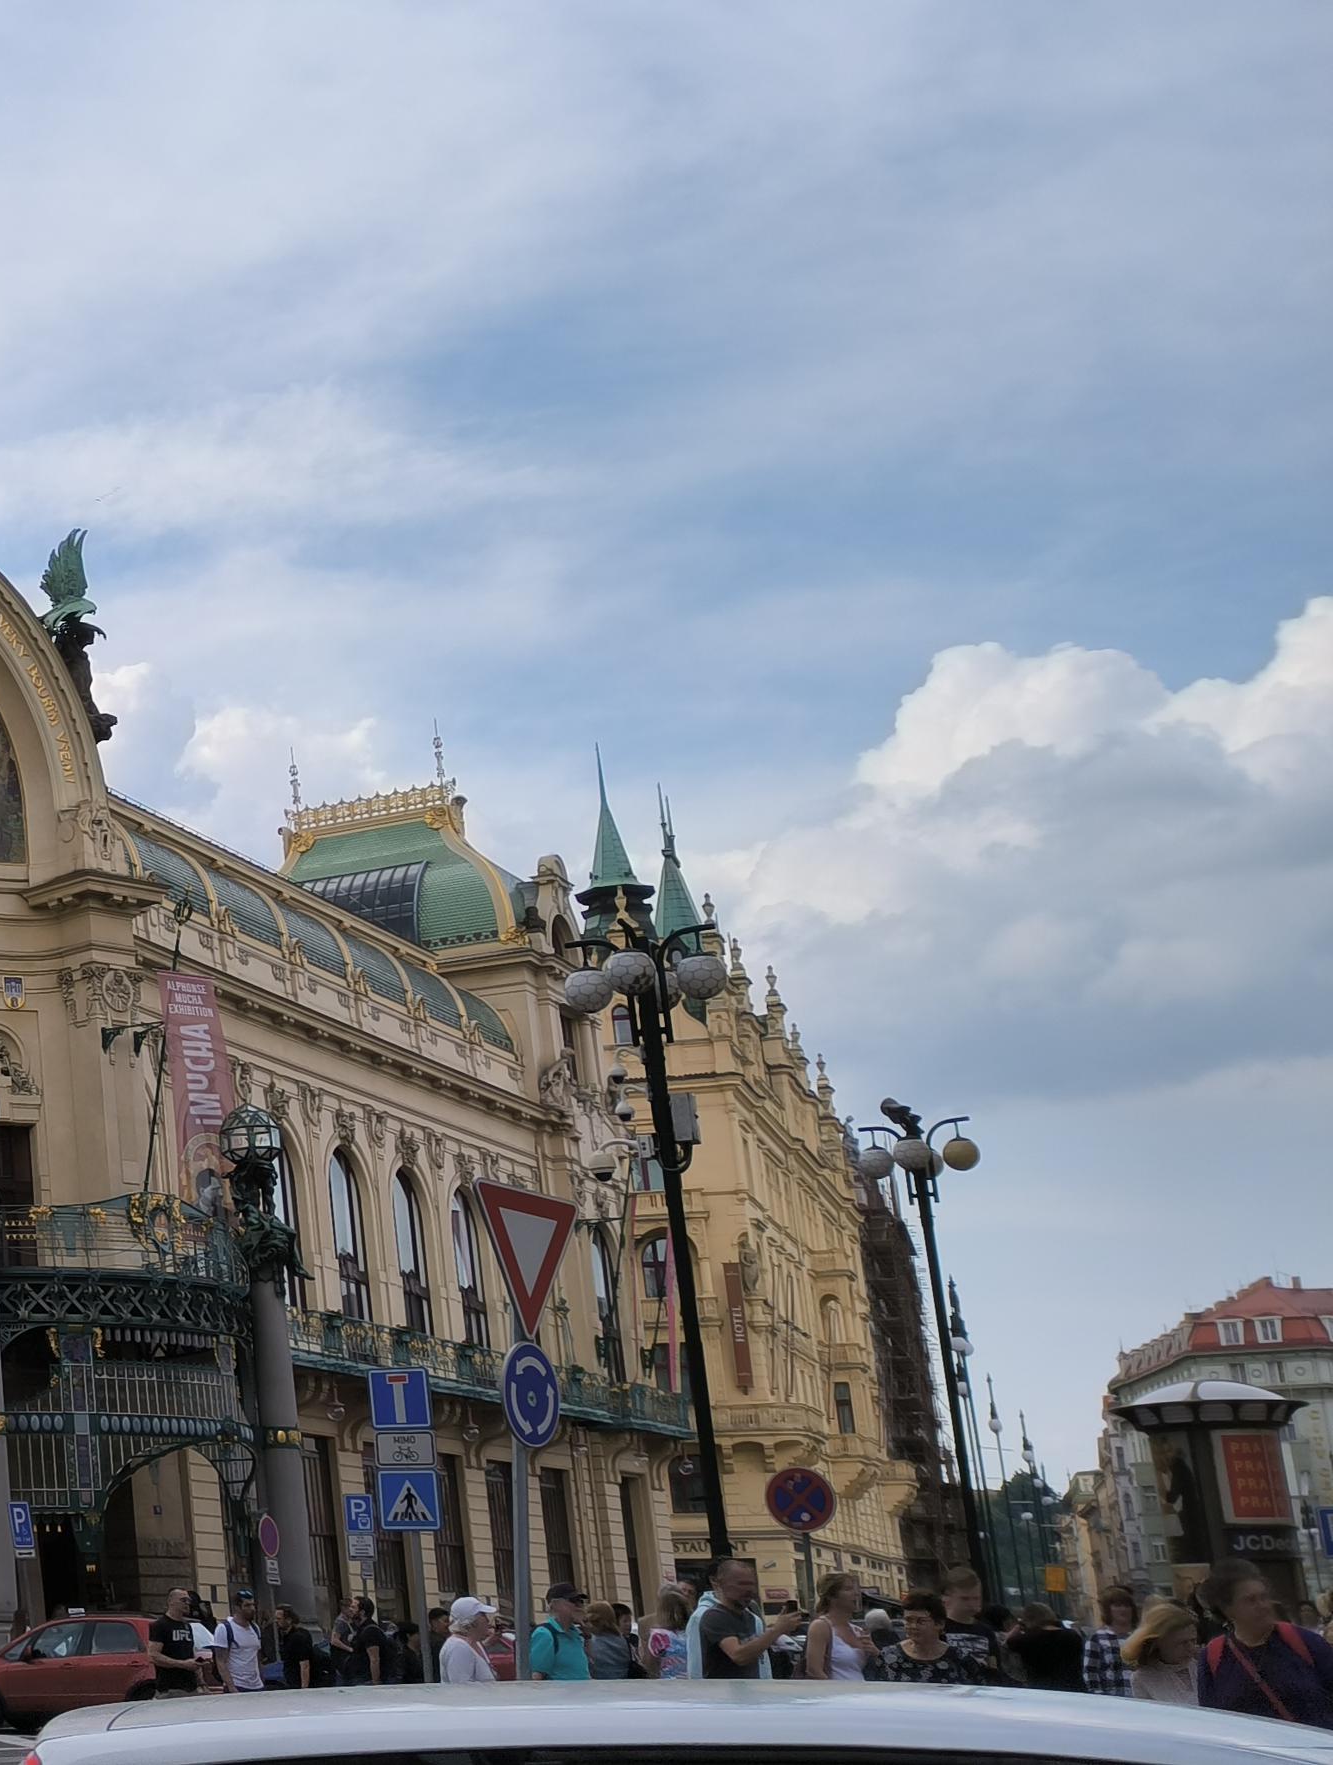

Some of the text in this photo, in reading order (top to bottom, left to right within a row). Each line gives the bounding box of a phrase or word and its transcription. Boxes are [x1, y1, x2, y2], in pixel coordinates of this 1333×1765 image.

[166, 979, 208, 995] ALPHONSE
[174, 991, 204, 1006] MUCHA
[168, 1003, 214, 1018] EXHIBITION
[731, 1305, 746, 1343] HOTEL
[393, 1435, 416, 1445] MIMO
[350, 1499, 366, 1521] P
[13, 1507, 26, 1534] P
[173, 1629, 191, 1641] UFC
